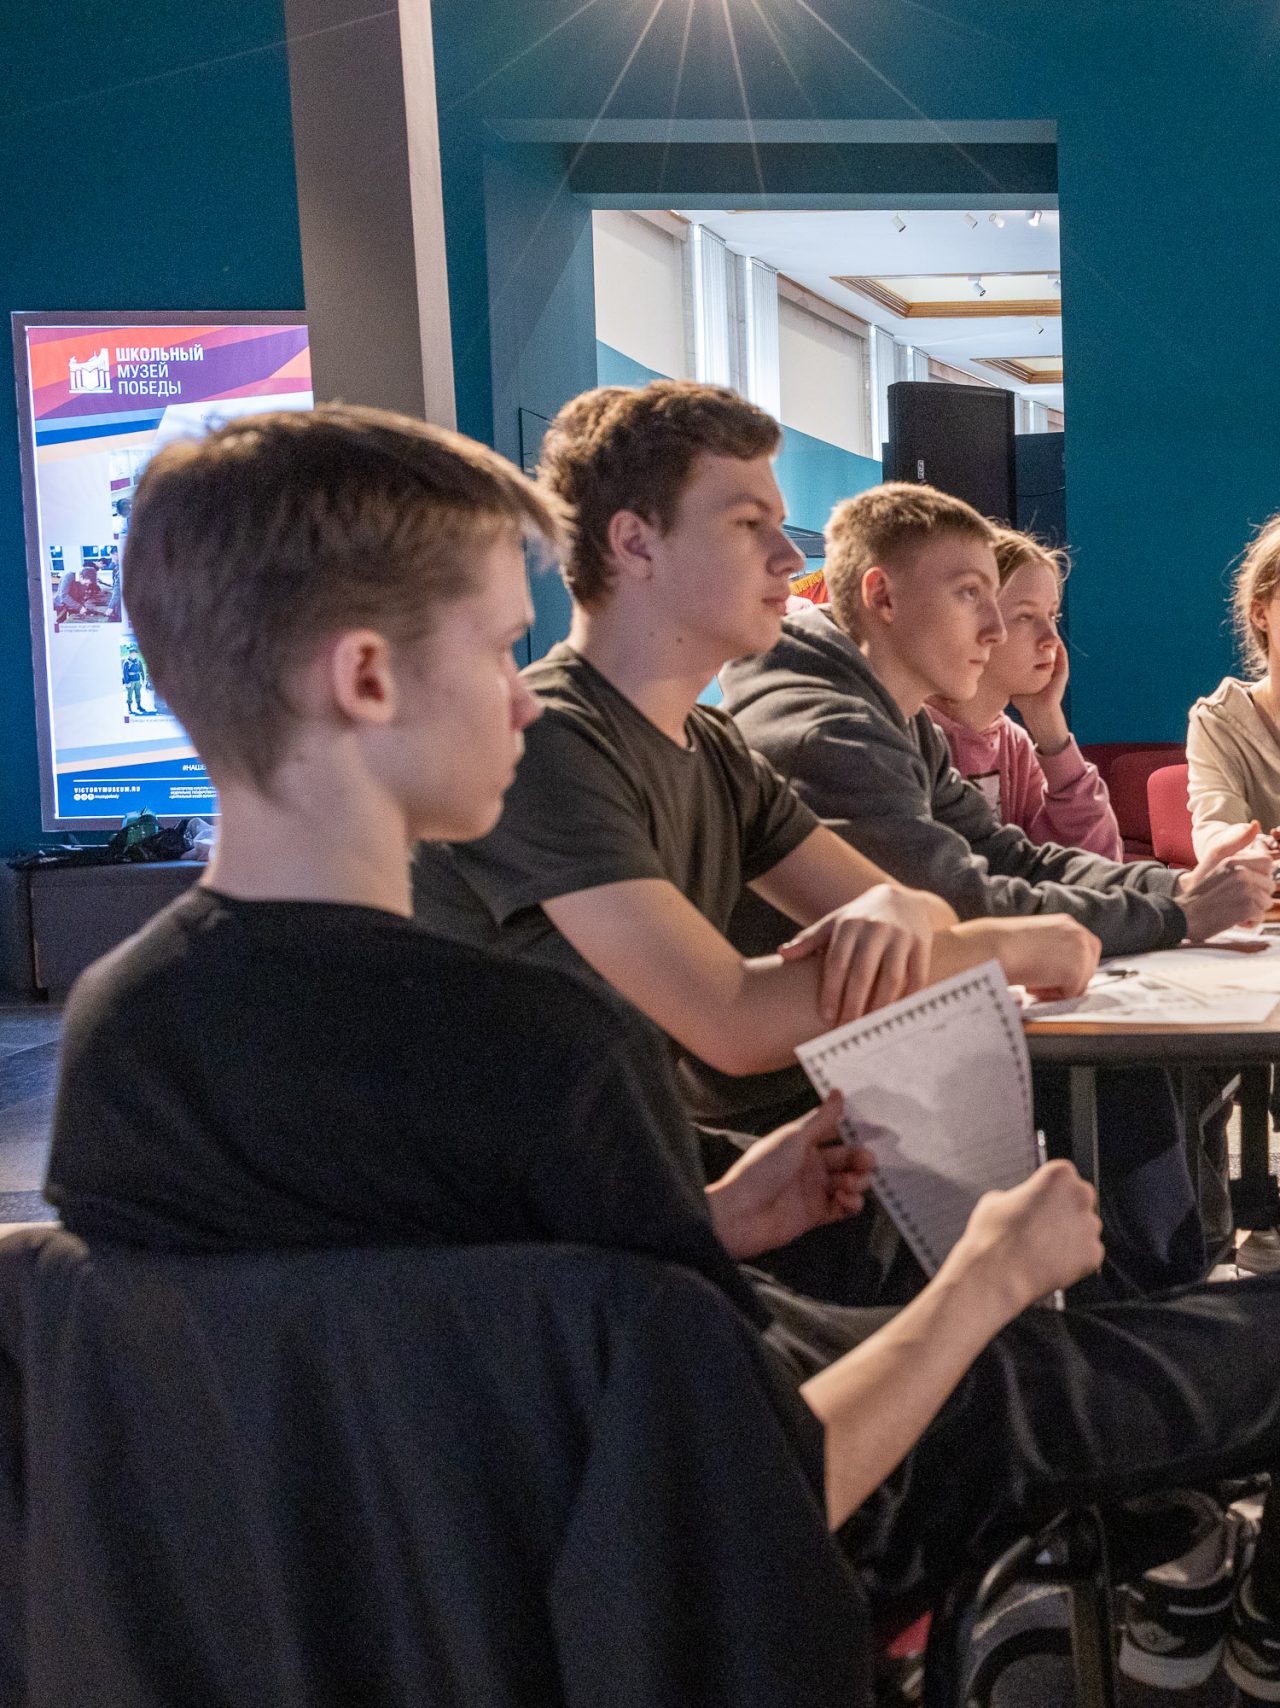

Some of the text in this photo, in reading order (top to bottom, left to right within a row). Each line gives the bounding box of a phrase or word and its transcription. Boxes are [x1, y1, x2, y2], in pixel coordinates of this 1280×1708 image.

[115, 343, 204, 361] ШКОЛЬНЫЙ
[117, 361, 169, 378] МУЗЕЙ
[118, 380, 182, 397] ПОБЕДЫ
